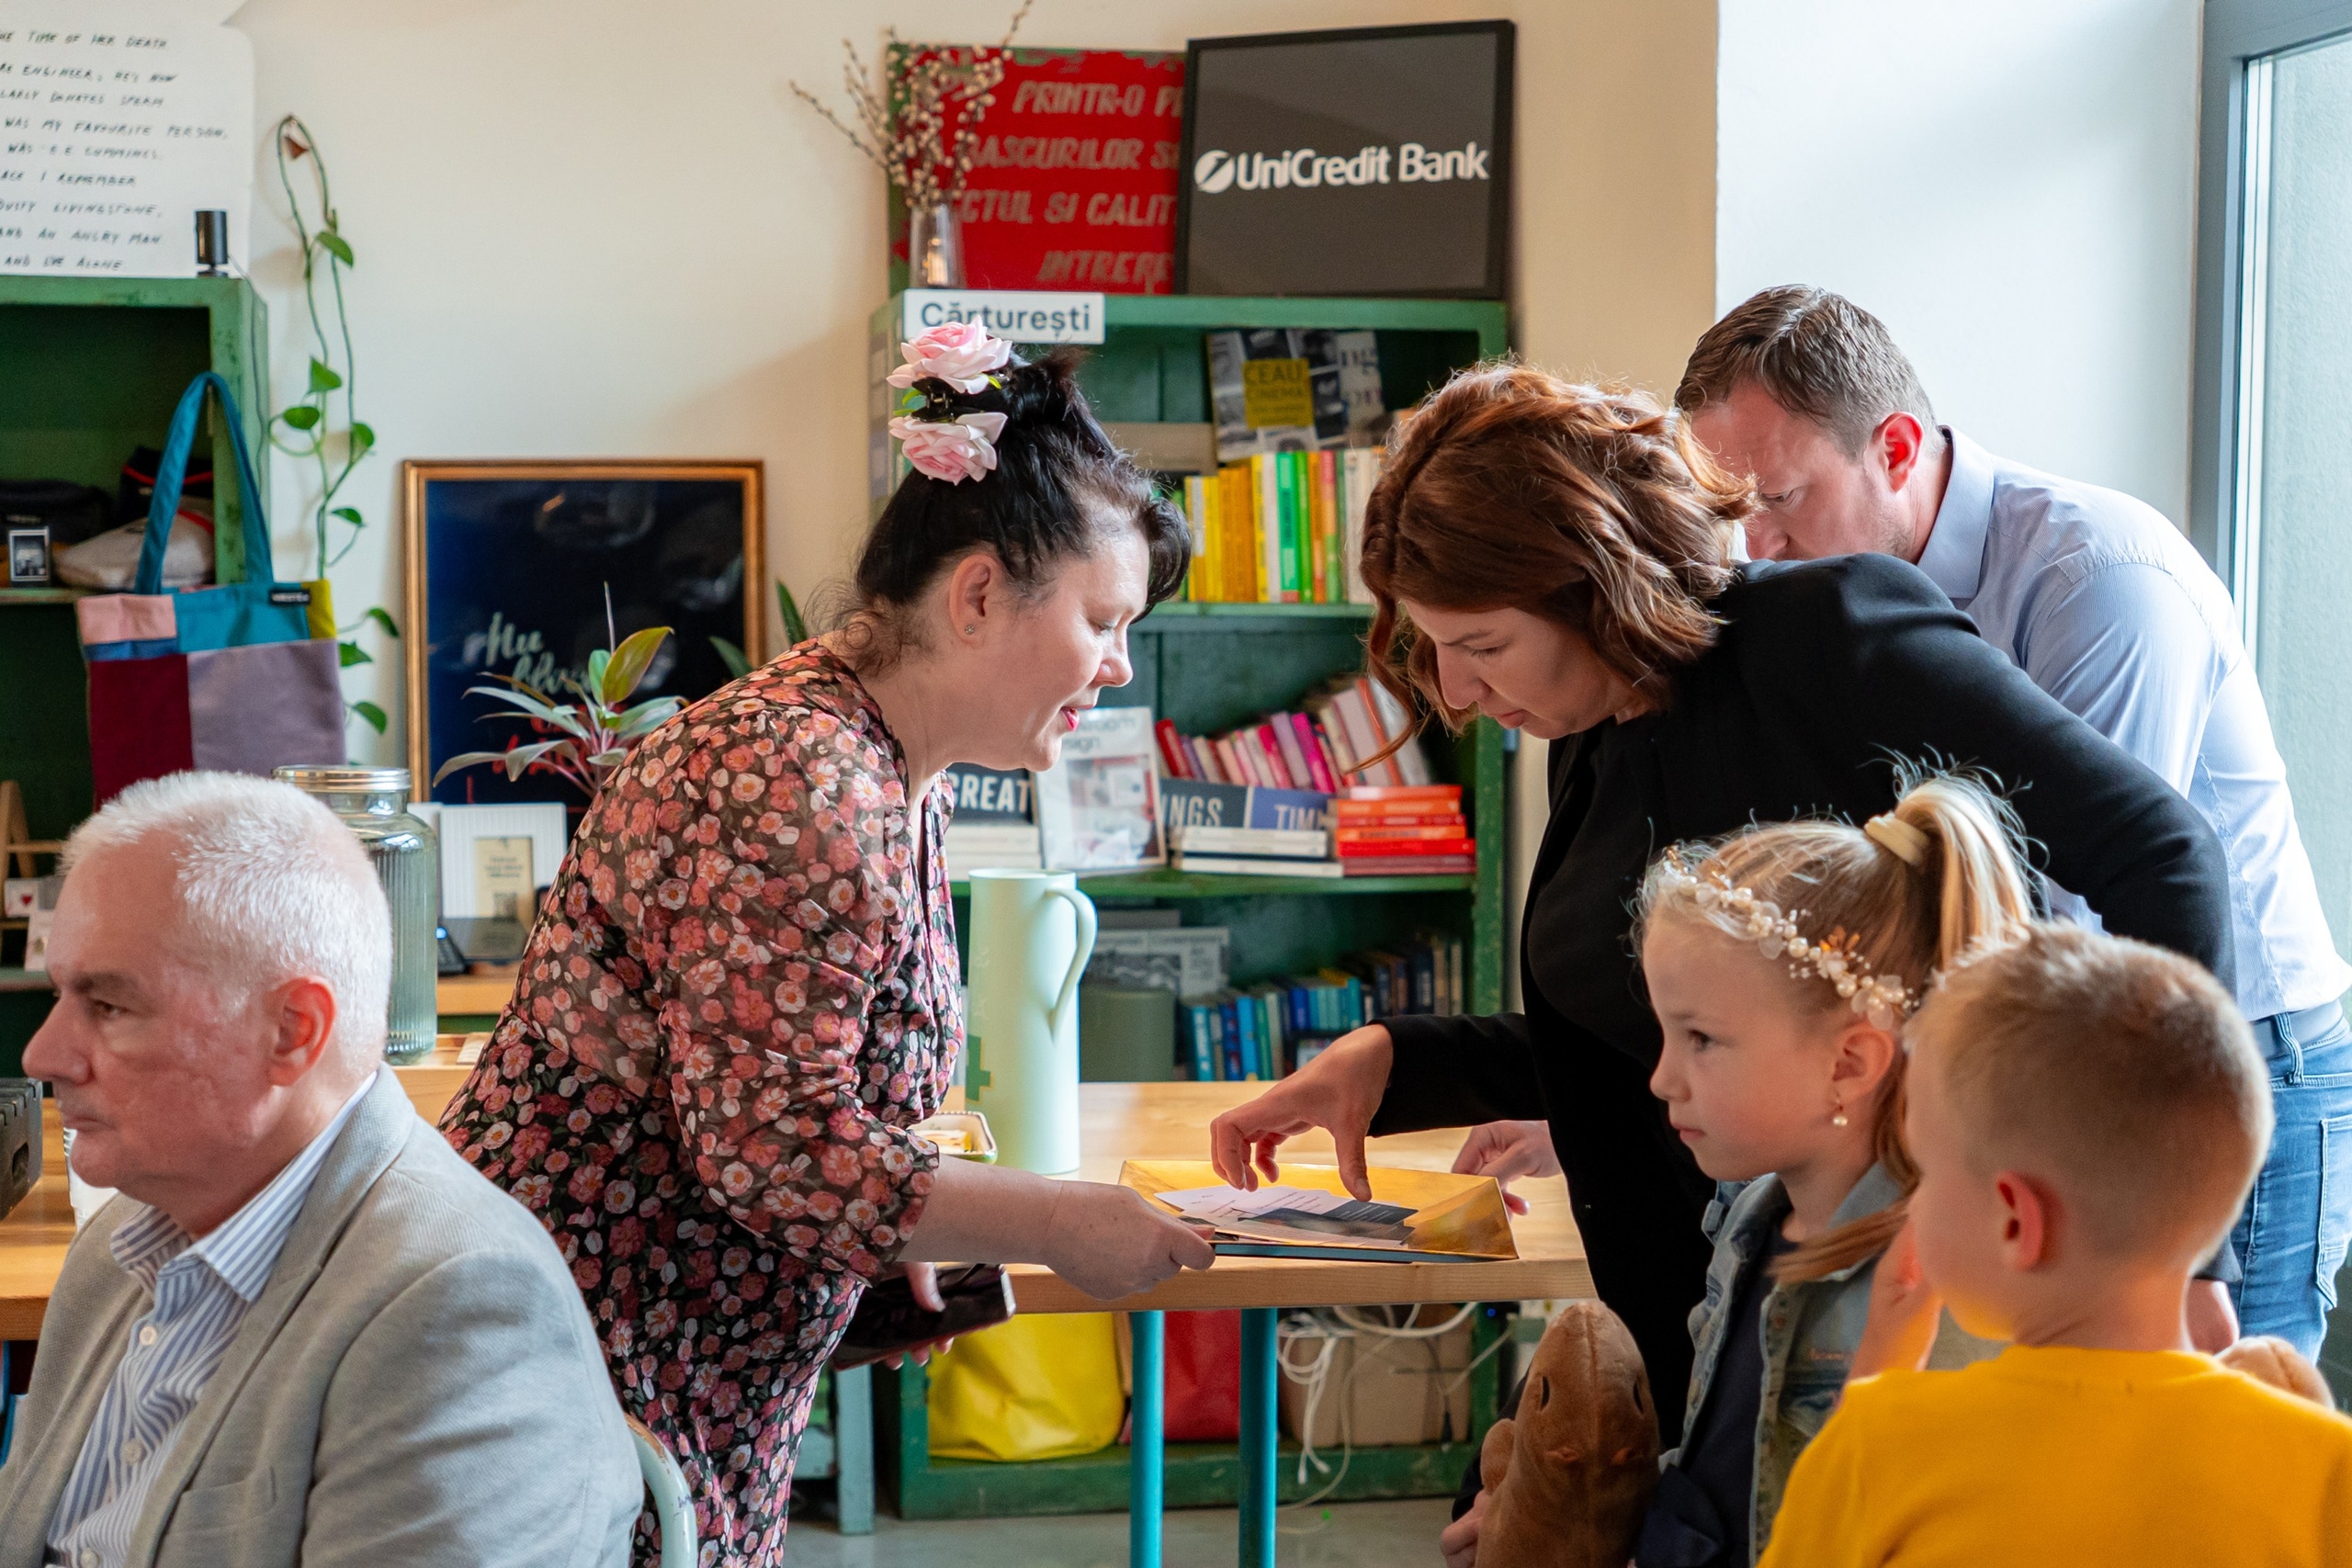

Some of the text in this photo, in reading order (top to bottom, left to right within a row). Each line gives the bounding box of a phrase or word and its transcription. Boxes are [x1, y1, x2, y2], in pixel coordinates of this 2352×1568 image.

[28, 29, 57, 43] TIME
[64, 33, 82, 44] OF
[91, 34, 116, 46] HER
[126, 37, 168, 50] DEATH
[5, 116, 29, 129] WAS
[41, 119, 62, 132] MY
[74, 120, 153, 137] FAVOURITE
[7, 142, 32, 154] WAS
[1237, 141, 1490, 190] UniCredit Bank
[57, 172, 137, 187] REMEMBER
[1087, 193, 1177, 227] CALIT
[72, 230, 120, 245] ANGRY
[128, 231, 163, 245] MAN
[5, 254, 30, 267] AND
